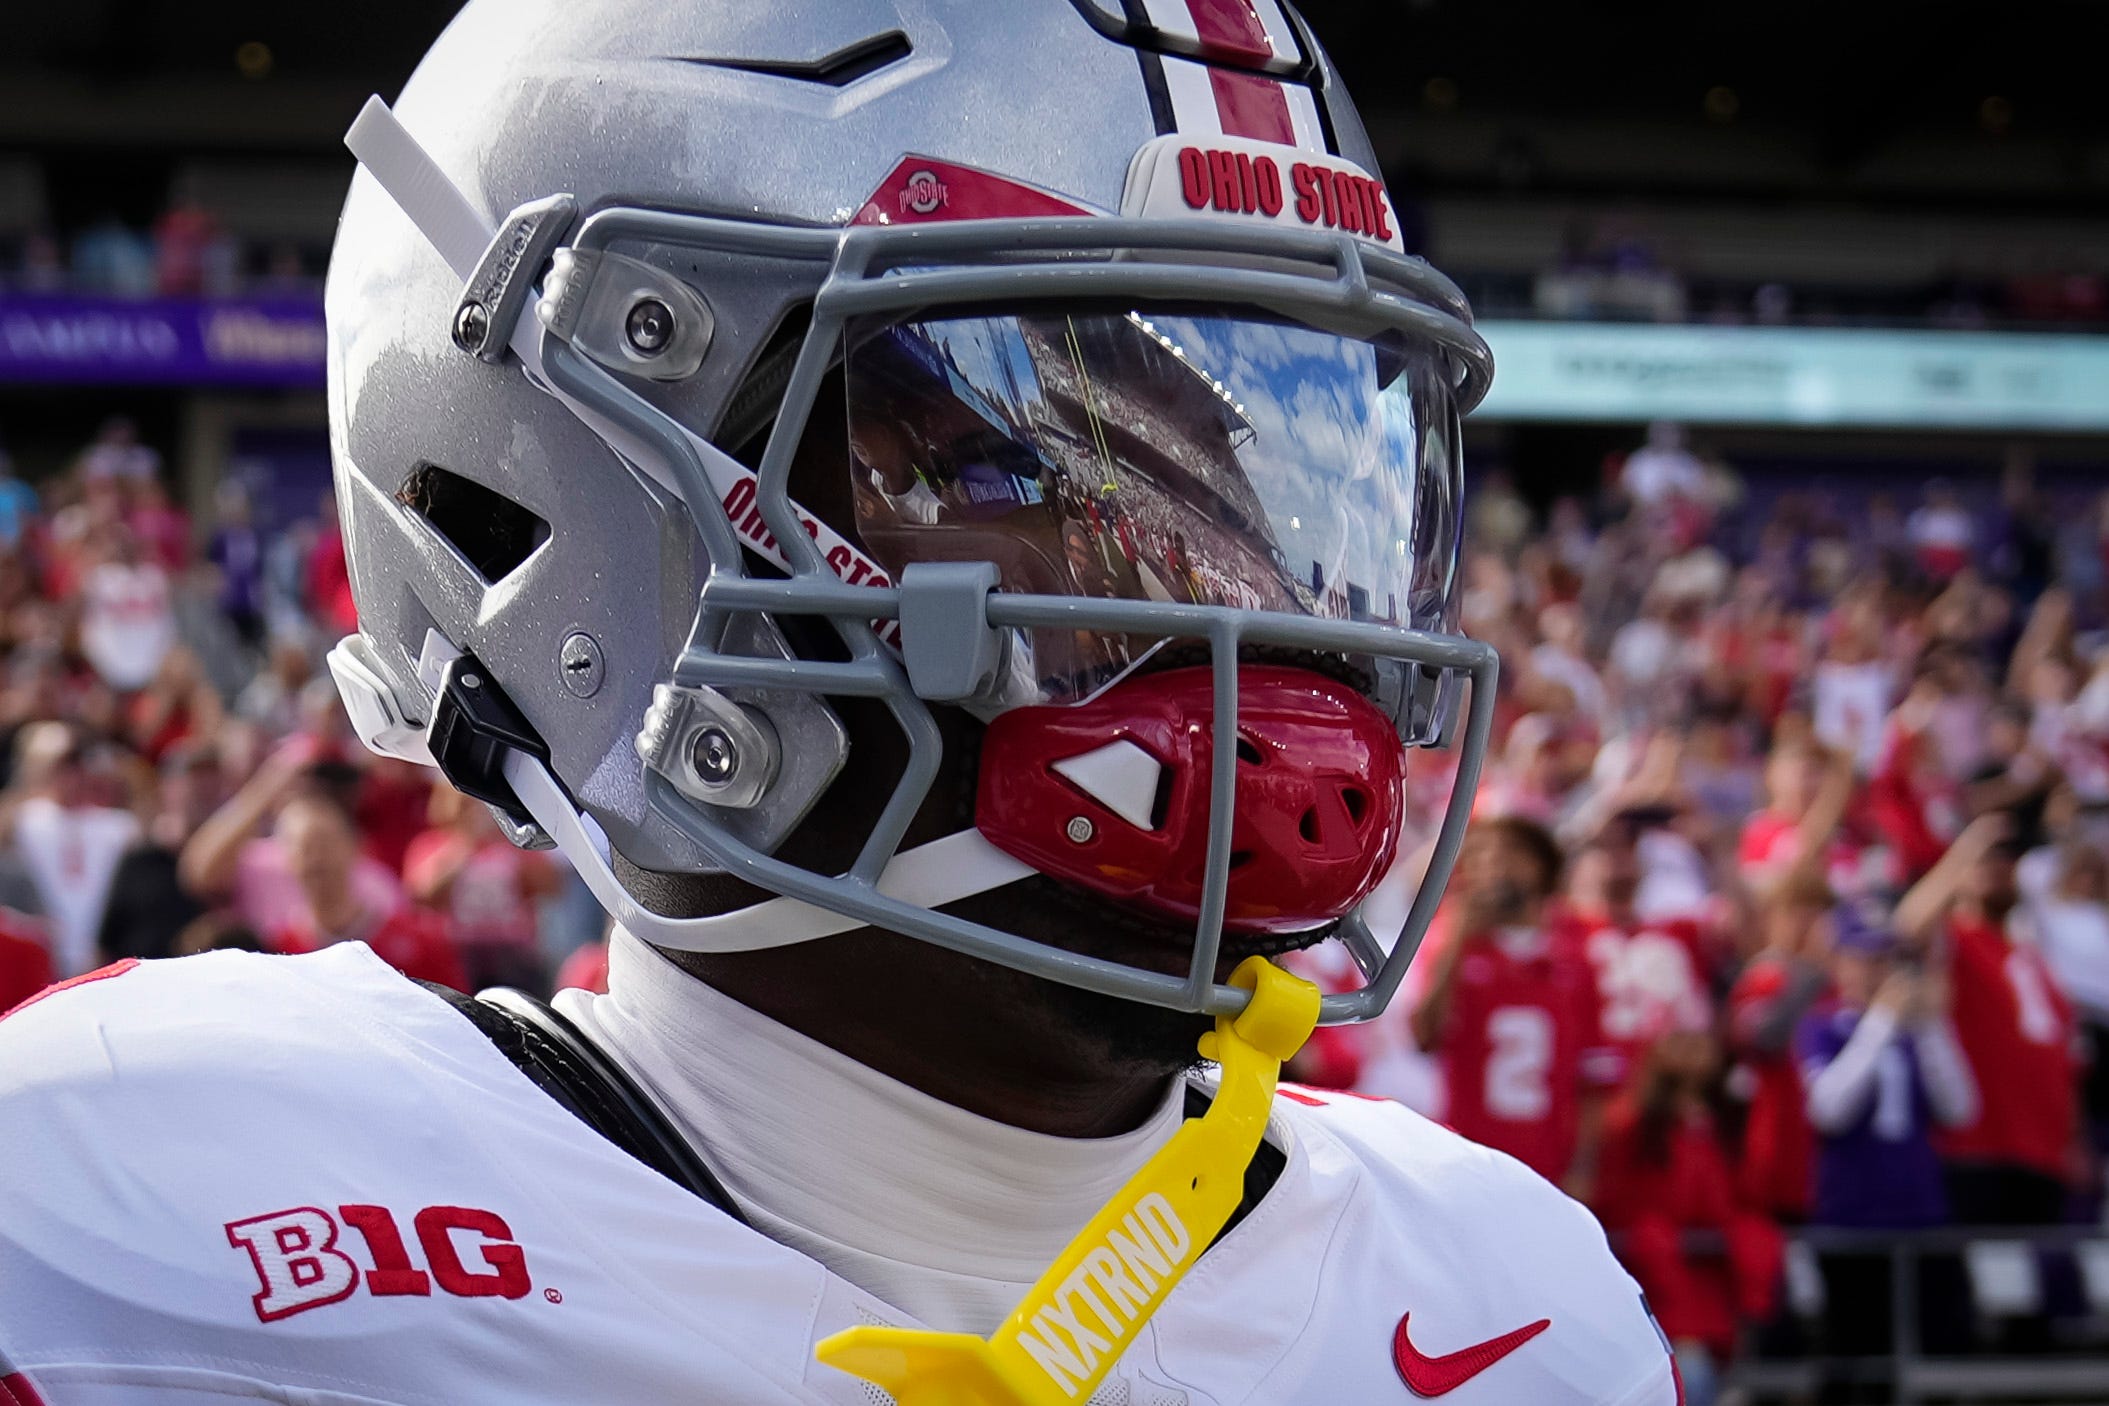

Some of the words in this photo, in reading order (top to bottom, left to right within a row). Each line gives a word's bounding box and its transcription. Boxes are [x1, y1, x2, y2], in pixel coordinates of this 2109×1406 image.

[1178, 146, 1283, 217] OHIO
[1292, 162, 1392, 241] STATE
[1485, 1006, 1553, 1119] 2
[1016, 1192, 1190, 1398] NXTRND
